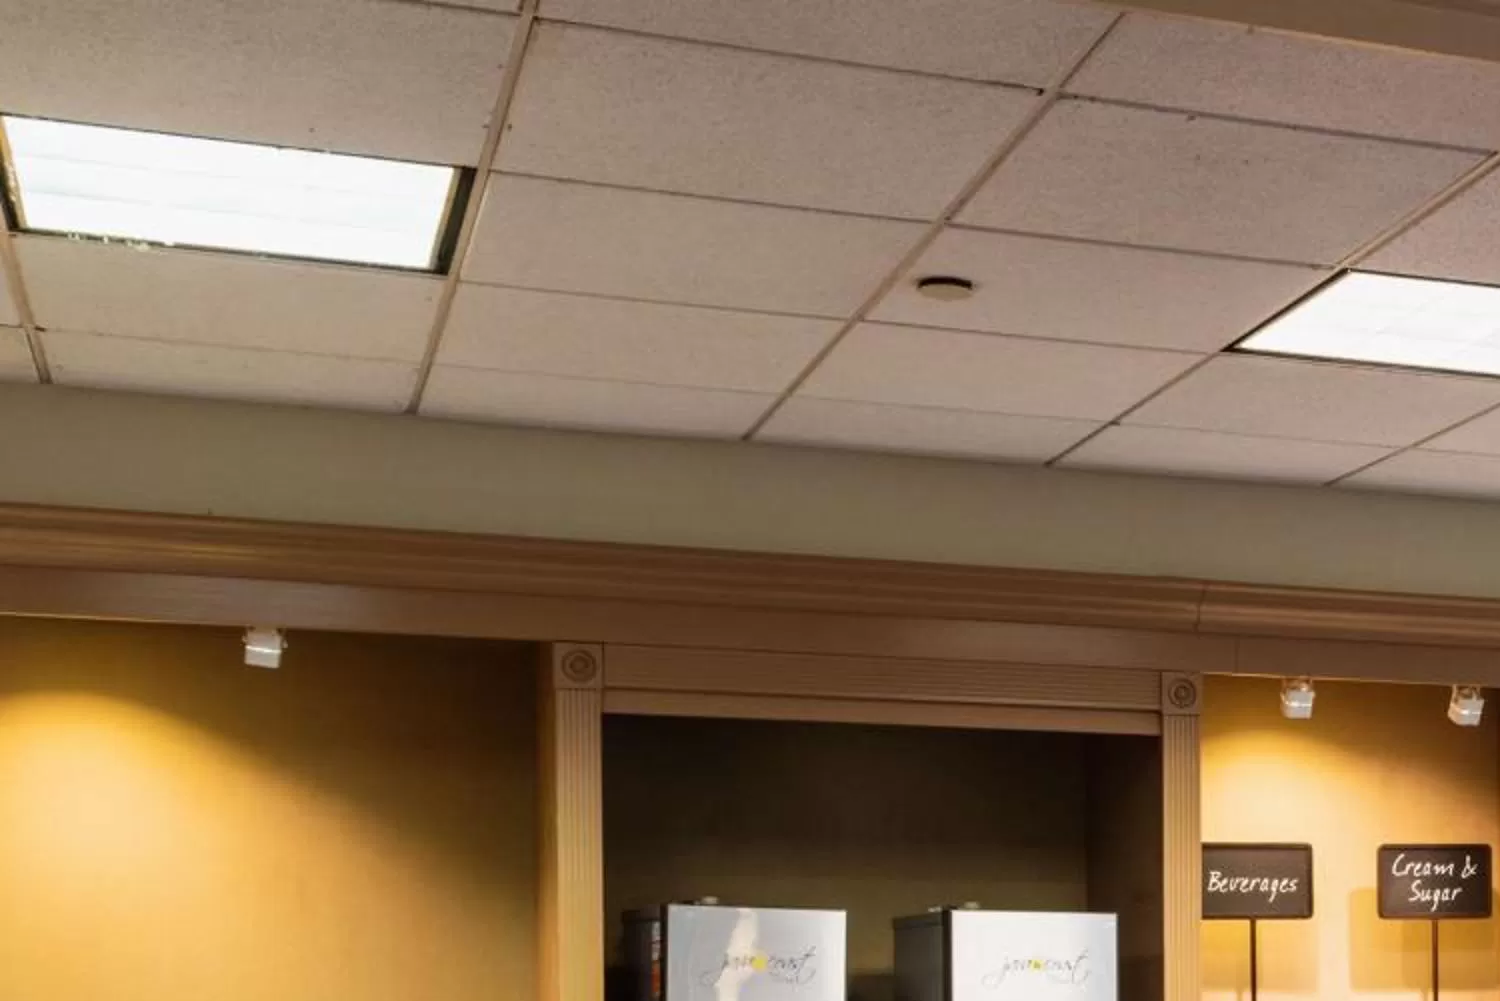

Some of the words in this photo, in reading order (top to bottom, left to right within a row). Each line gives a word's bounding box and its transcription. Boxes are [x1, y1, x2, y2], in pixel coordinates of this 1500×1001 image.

[1392, 853, 1455, 877] Cream
[1461, 855, 1478, 879] &
[1207, 870, 1299, 903] Beverages
[1408, 879, 1462, 912] Sugar
